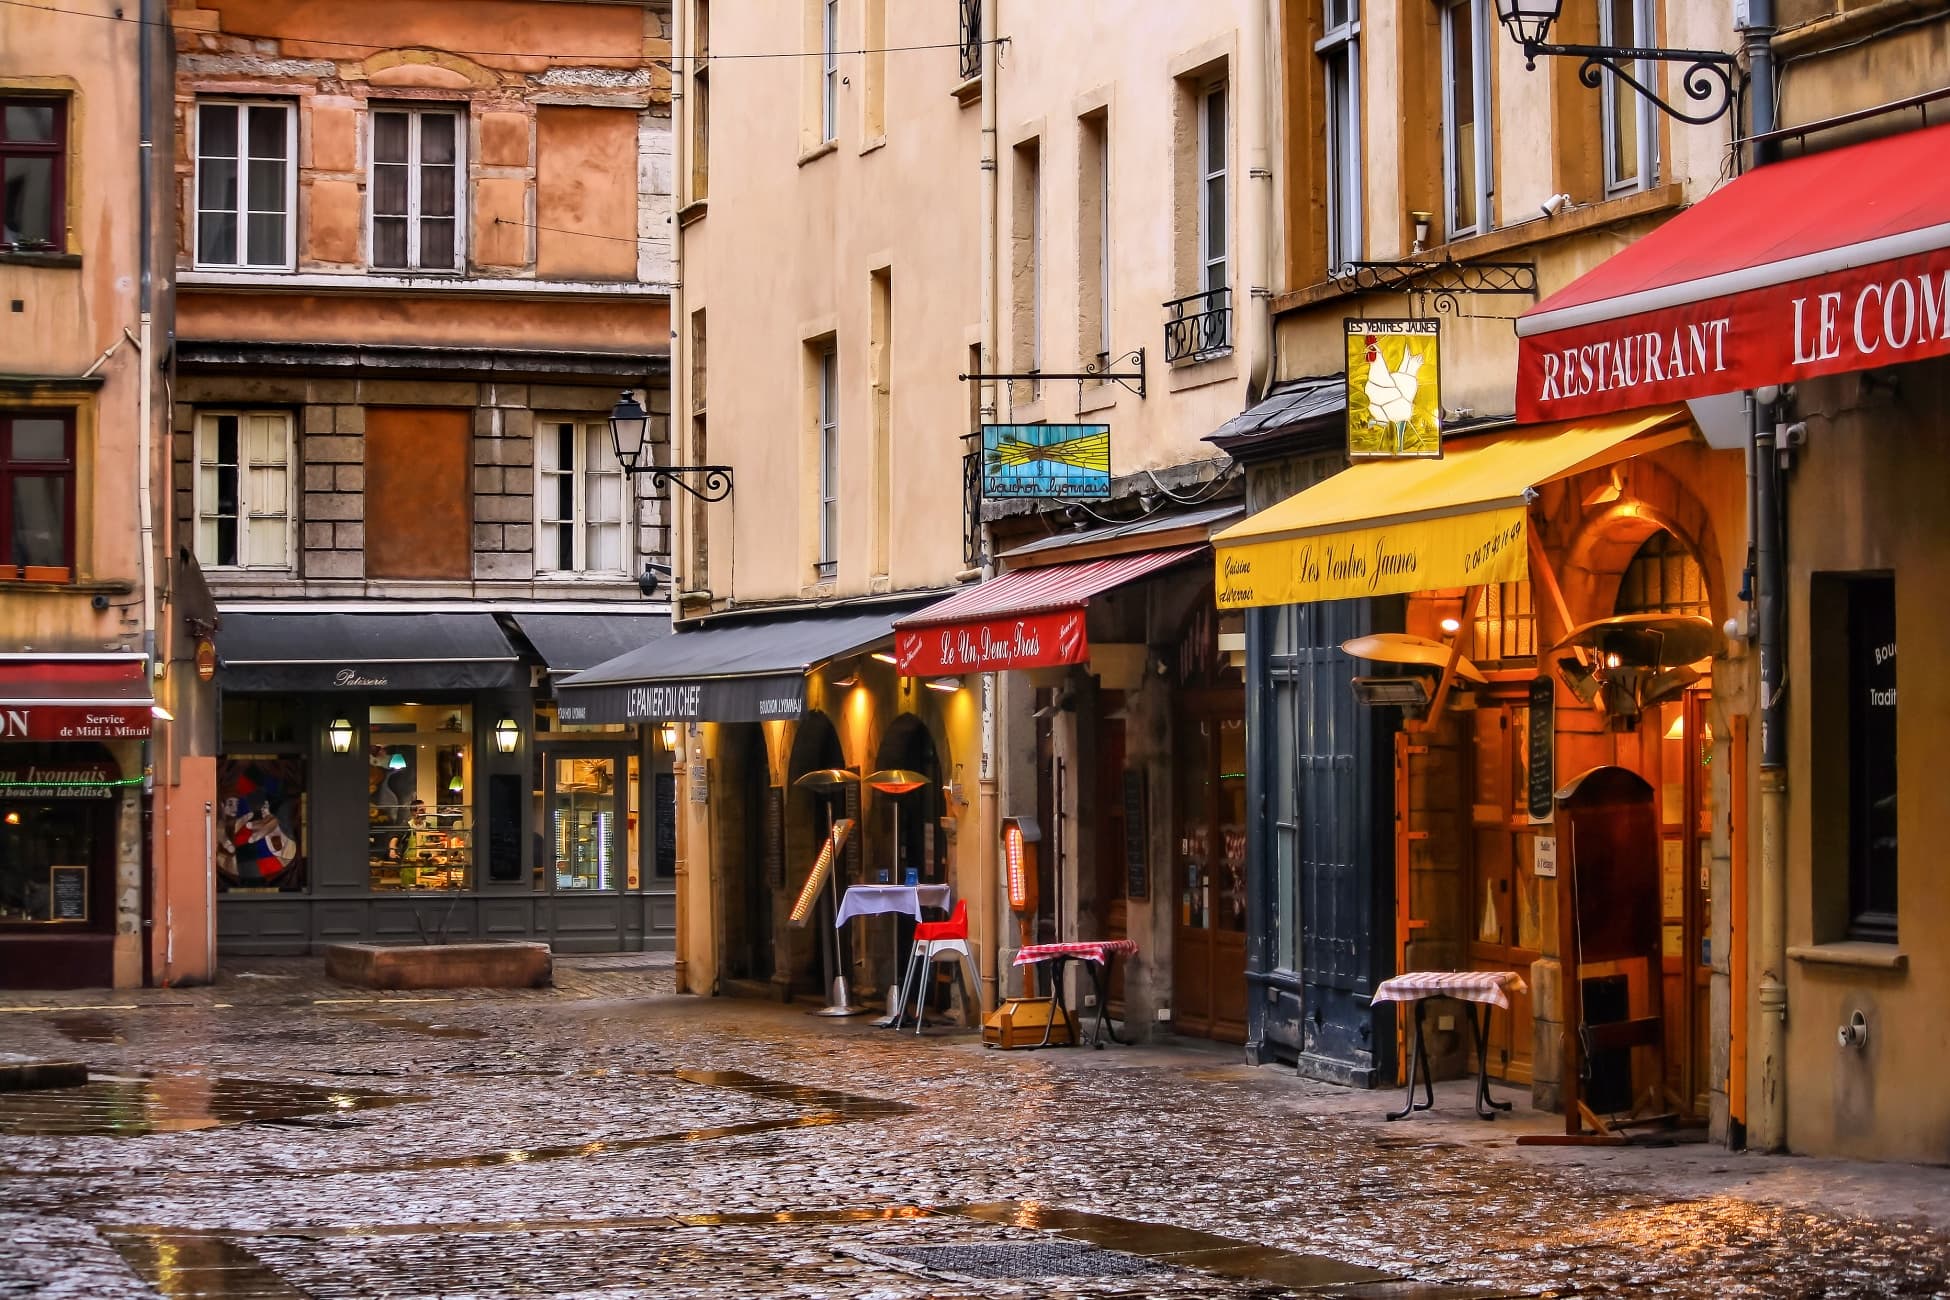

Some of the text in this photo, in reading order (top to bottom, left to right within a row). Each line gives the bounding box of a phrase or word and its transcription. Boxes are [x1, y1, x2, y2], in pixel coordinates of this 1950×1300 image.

[1366, 321, 1403, 333] VENTRES
[1405, 321, 1437, 333] JAUNES
[1791, 270, 1950, 365] LE COM
[1539, 318, 1730, 401] RESTAURANT
[1046, 476, 1109, 498] lyonnais
[1224, 555, 1251, 580] Cuisine
[1299, 544, 1320, 583] Les
[1326, 543, 1367, 582] Ventres
[1367, 535, 1418, 593] Jaunes
[940, 630, 955, 665] Le
[957, 629, 980, 670] Un,
[981, 625, 1012, 667] Deux,
[1013, 621, 1040, 658] Trois
[626, 688, 637, 718] LE
[664, 685, 677, 717] DU
[677, 684, 701, 717] CHEF
[60, 725, 151, 737] de Midi à Minuit
[86, 714, 126, 725] Service
[5, 787, 54, 798] bouchon
